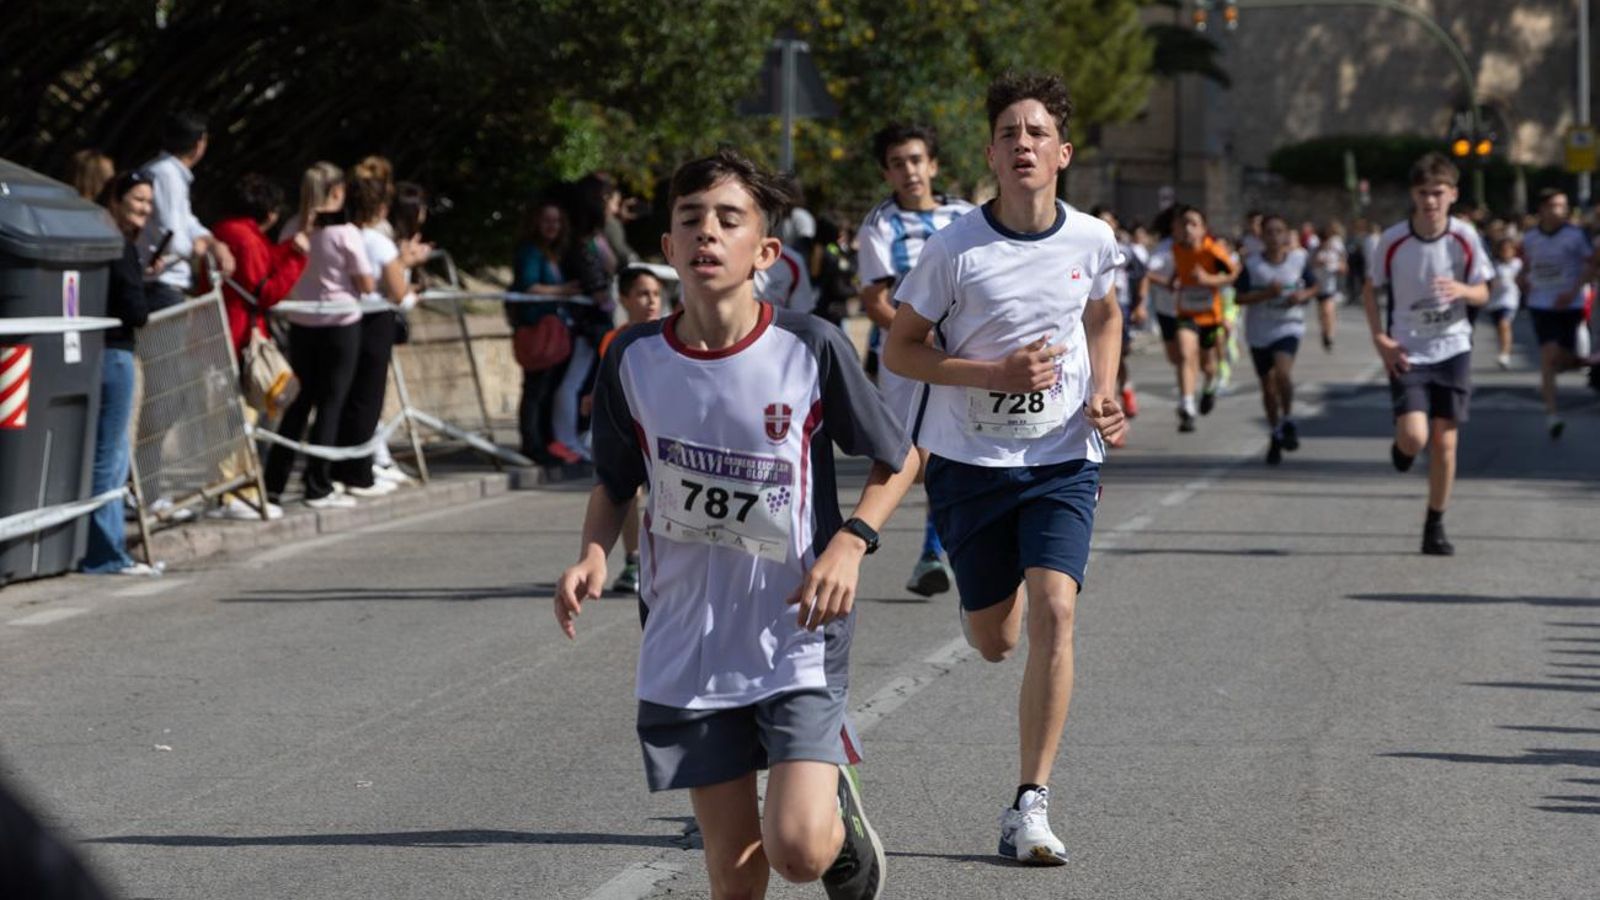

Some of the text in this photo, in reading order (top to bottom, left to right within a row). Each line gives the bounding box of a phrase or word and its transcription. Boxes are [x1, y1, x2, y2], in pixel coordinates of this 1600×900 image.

[989, 391, 1045, 414] 728
[729, 465, 778, 481] LA GLORIA
[681, 479, 759, 524] 787
